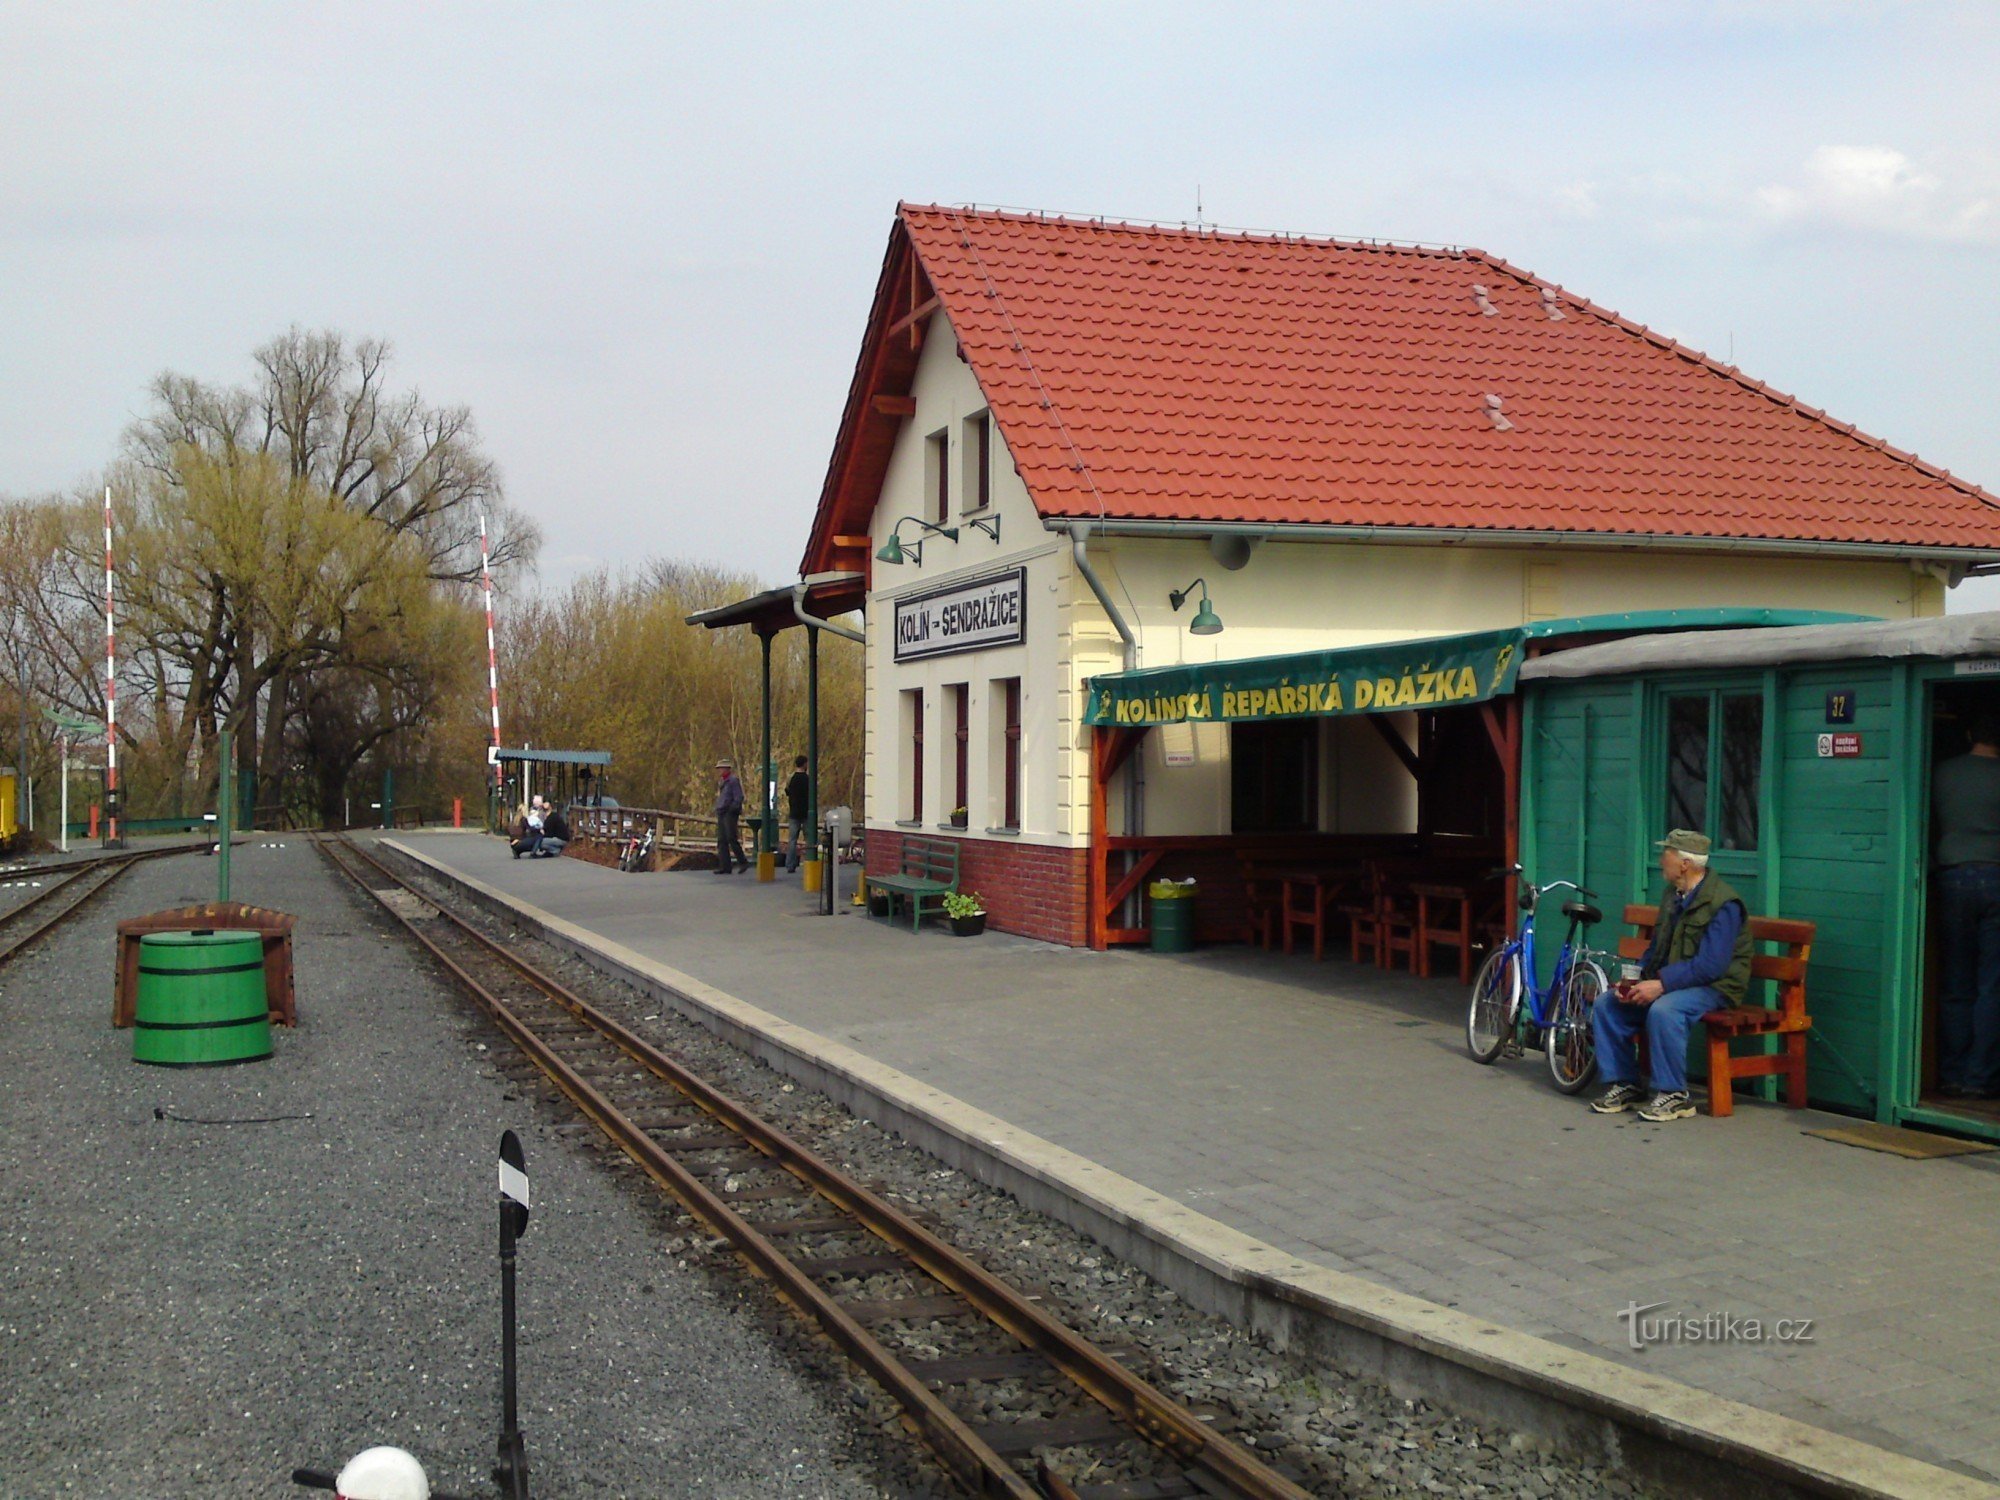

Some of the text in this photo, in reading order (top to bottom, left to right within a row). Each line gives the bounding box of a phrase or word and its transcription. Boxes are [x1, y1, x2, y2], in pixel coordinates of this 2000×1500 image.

[1116, 662, 1478, 723] KOLÍNSKÁ ŘEPAŘSKÁ DRÁŽKA
[1832, 696, 1845, 717] 32
